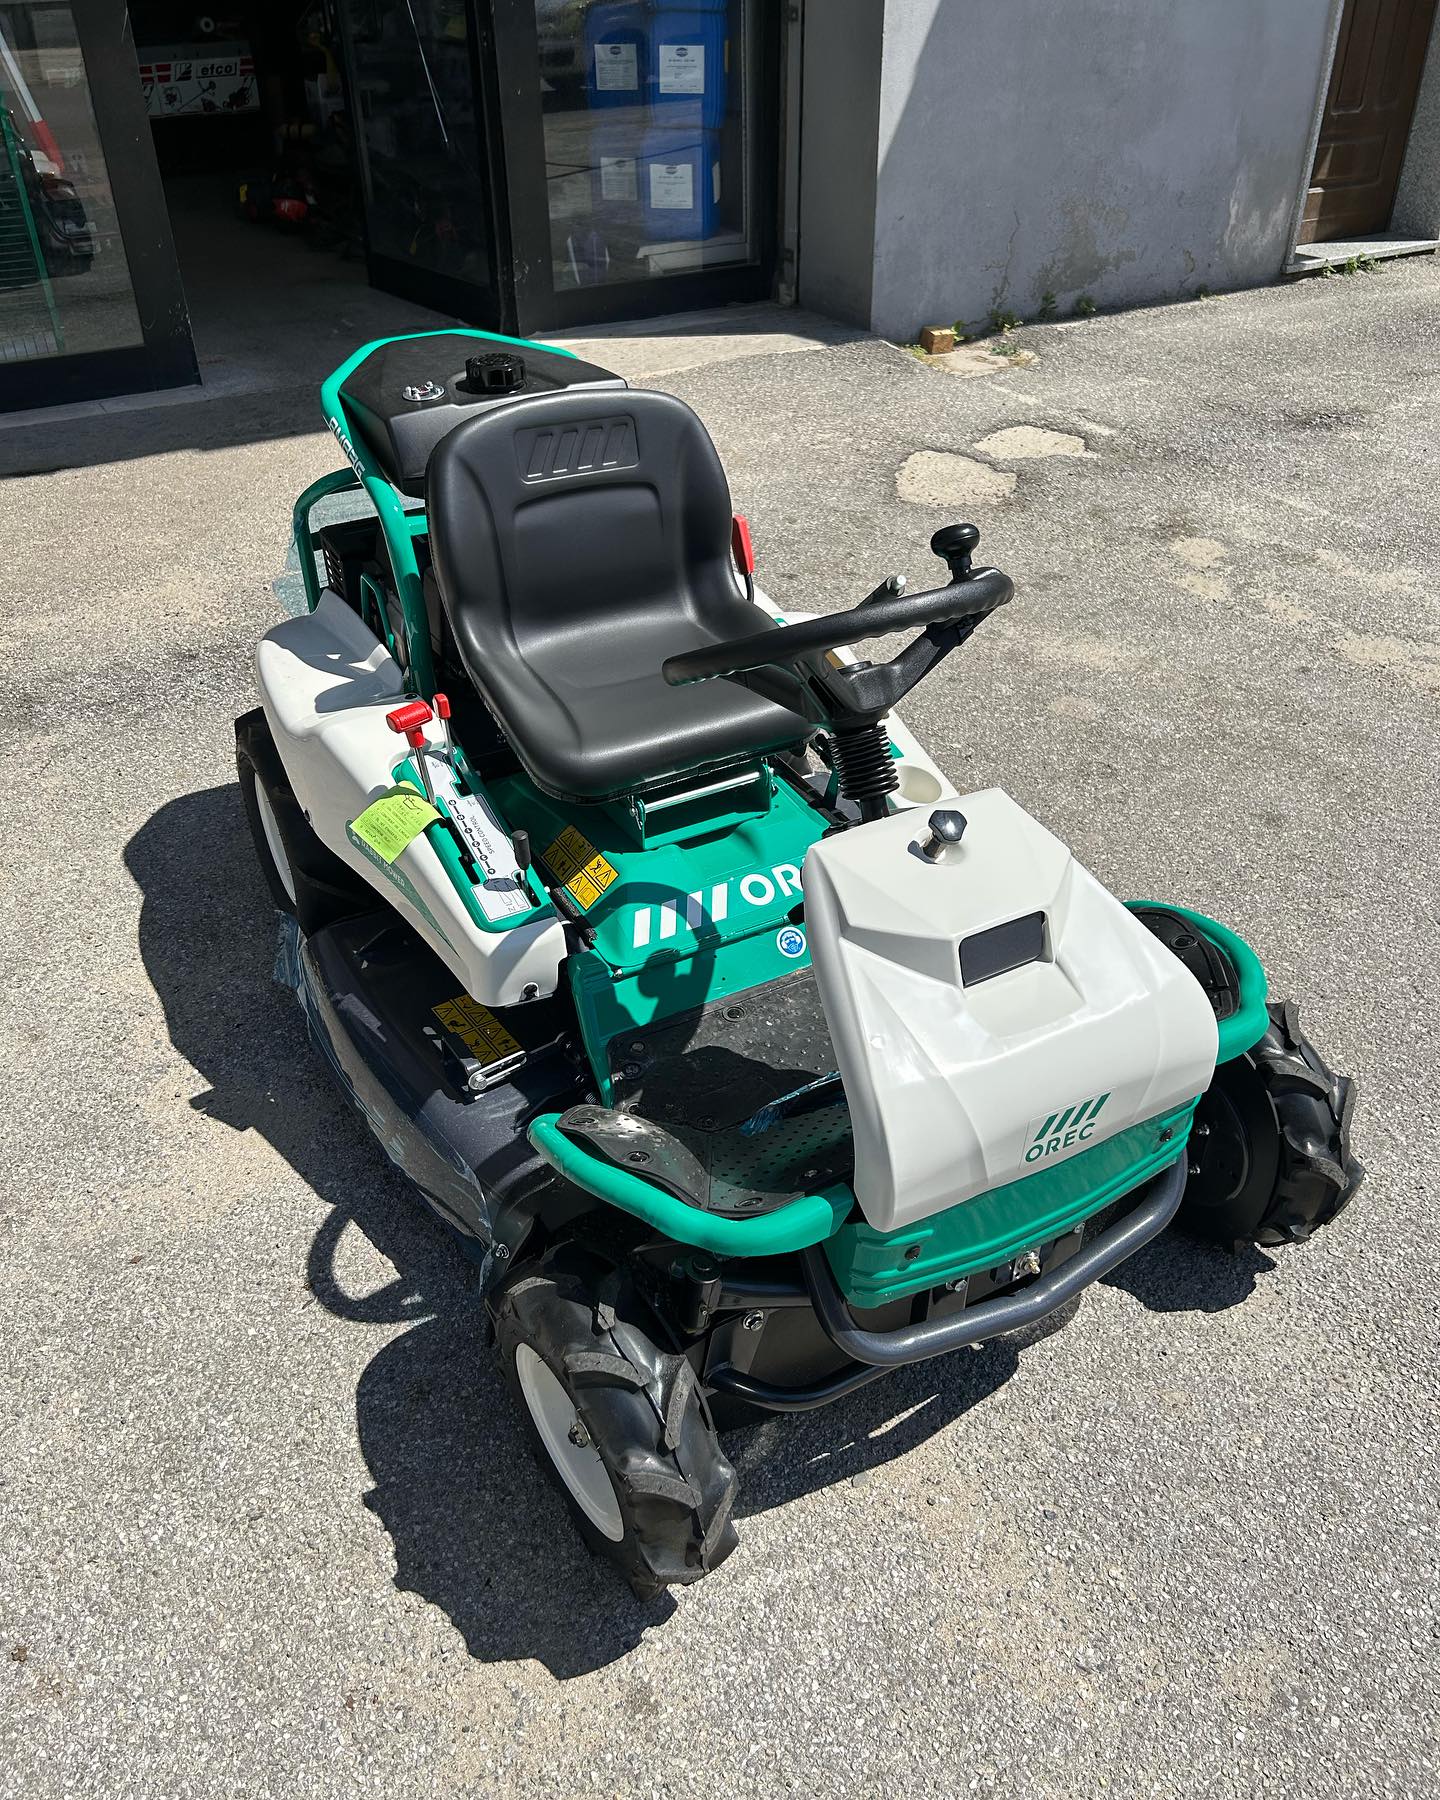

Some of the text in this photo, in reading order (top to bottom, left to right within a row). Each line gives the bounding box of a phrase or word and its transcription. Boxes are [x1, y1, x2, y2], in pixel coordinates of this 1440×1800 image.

[201, 63, 233, 76] efco
[469, 814, 484, 838] CONTROL
[480, 837, 494, 854] SPEED
[740, 860, 805, 905] OR
[1025, 1122, 1095, 1162] OREC
